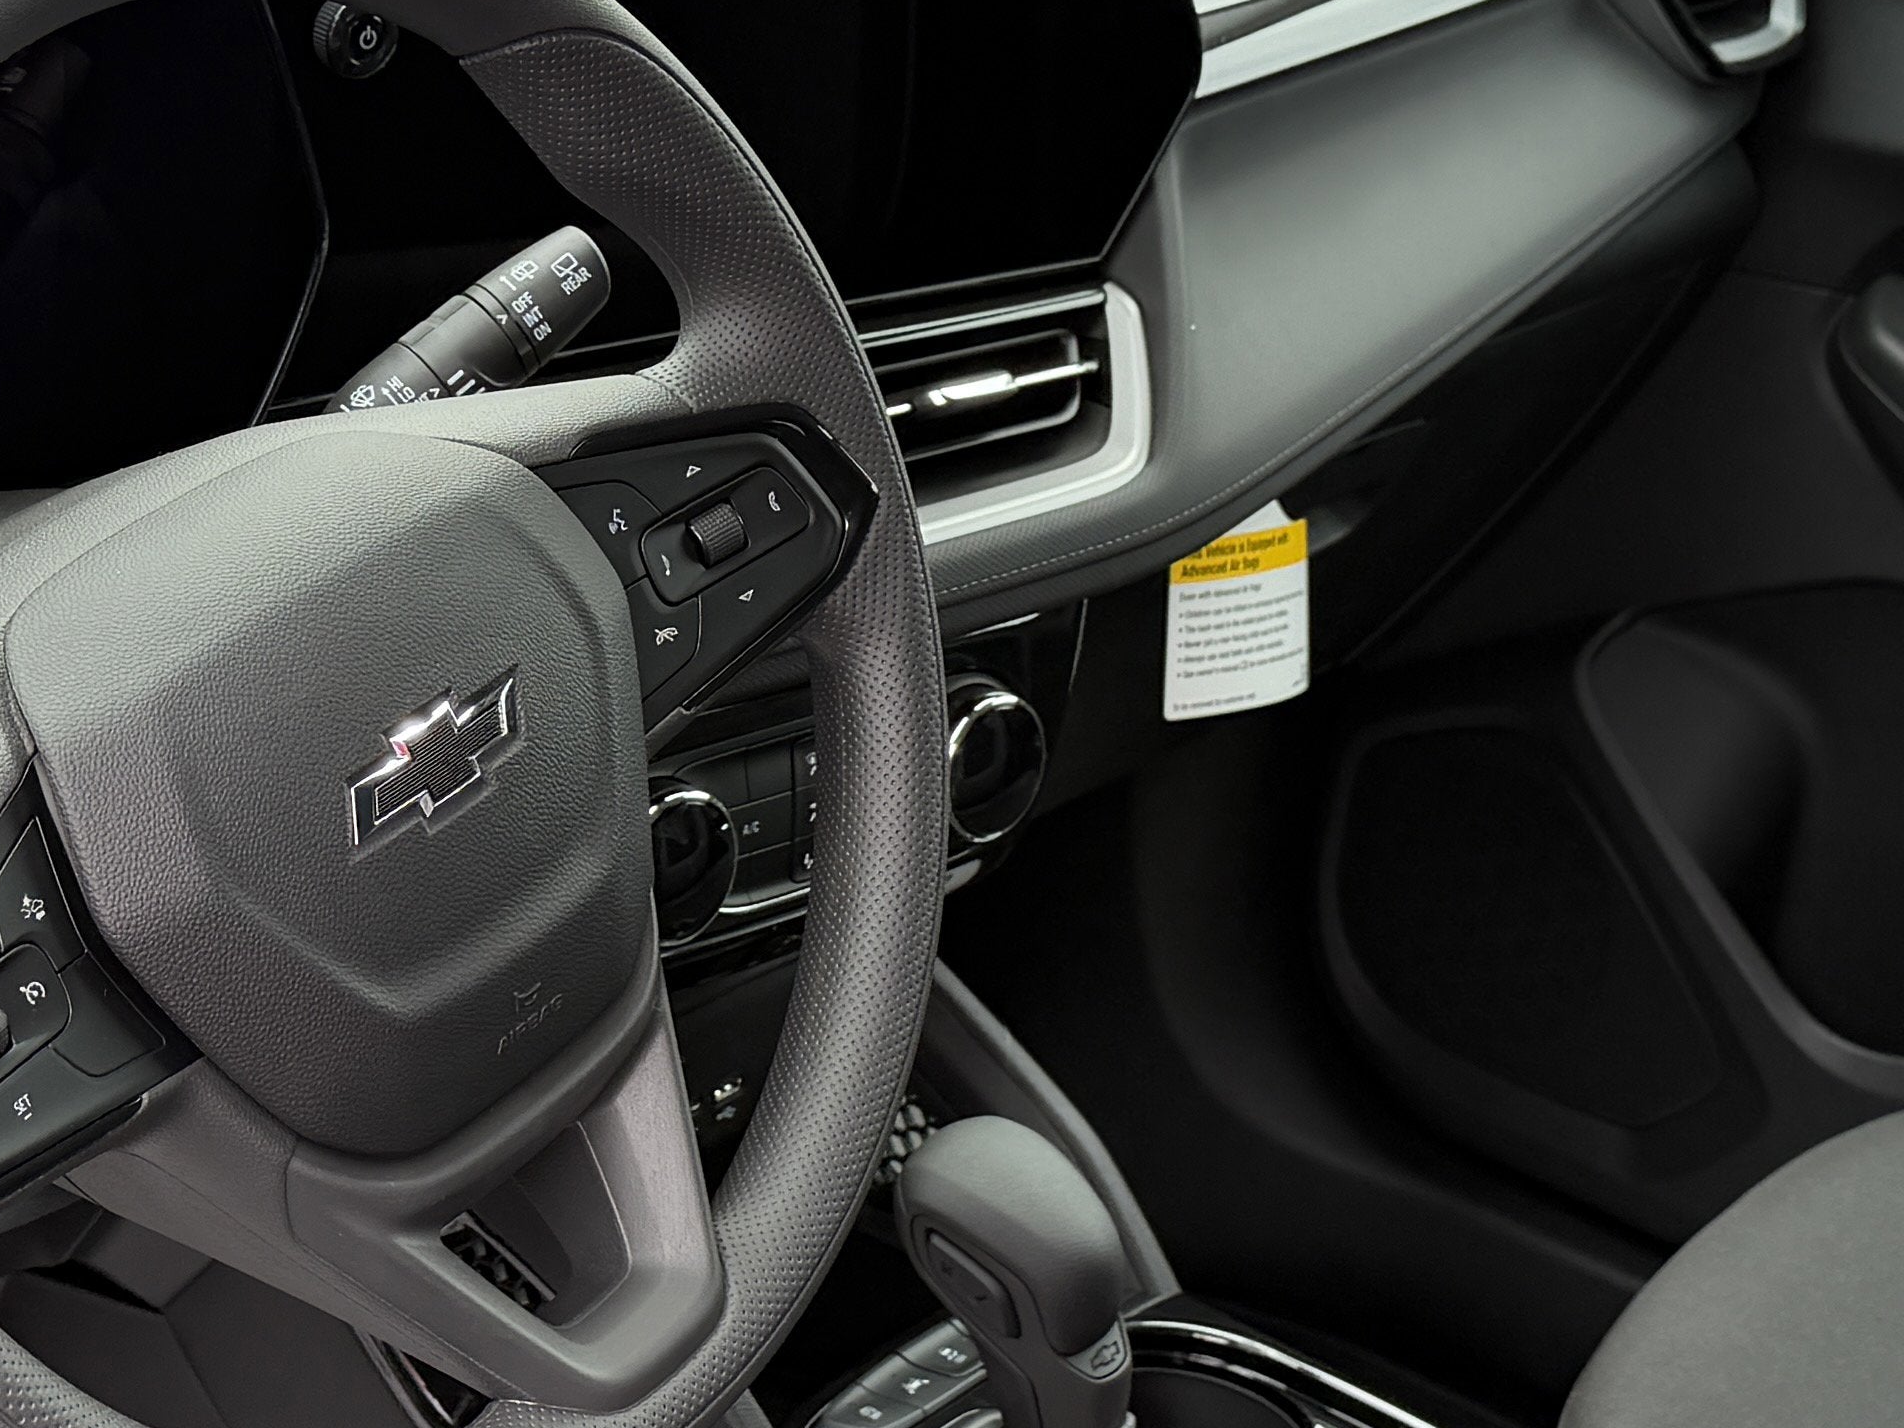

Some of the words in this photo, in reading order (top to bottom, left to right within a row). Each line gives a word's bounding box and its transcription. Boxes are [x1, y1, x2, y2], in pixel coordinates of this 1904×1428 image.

[559, 267, 592, 296] REAR
[511, 291, 535, 315] OFF
[522, 309, 545, 329] INT
[533, 322, 552, 342] ON
[386, 375, 404, 392] HI
[13, 1093, 32, 1116] SET
